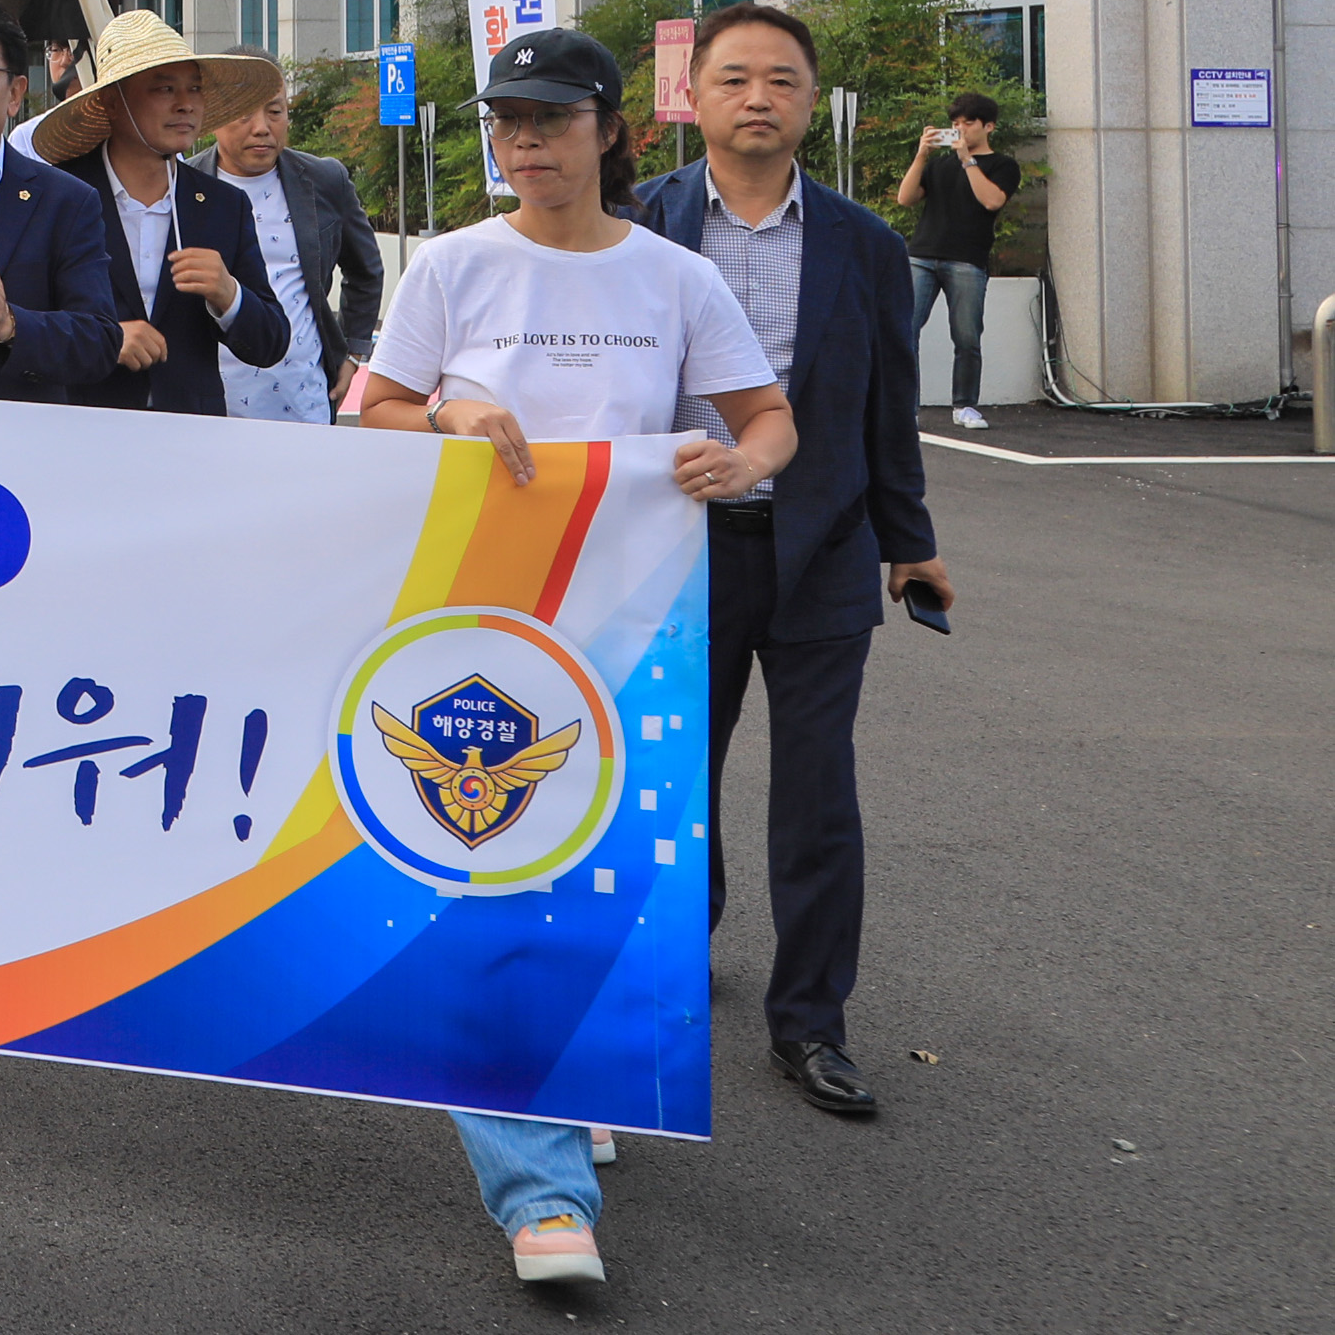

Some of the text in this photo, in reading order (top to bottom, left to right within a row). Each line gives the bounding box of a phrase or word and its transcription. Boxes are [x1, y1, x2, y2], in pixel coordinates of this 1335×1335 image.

[1198, 70, 1223, 79] CCTV
[493, 333, 659, 350] THE LOVE IS TO CHOOSE
[453, 698, 496, 713] POLICE
[432, 714, 518, 743] 해양경찰
